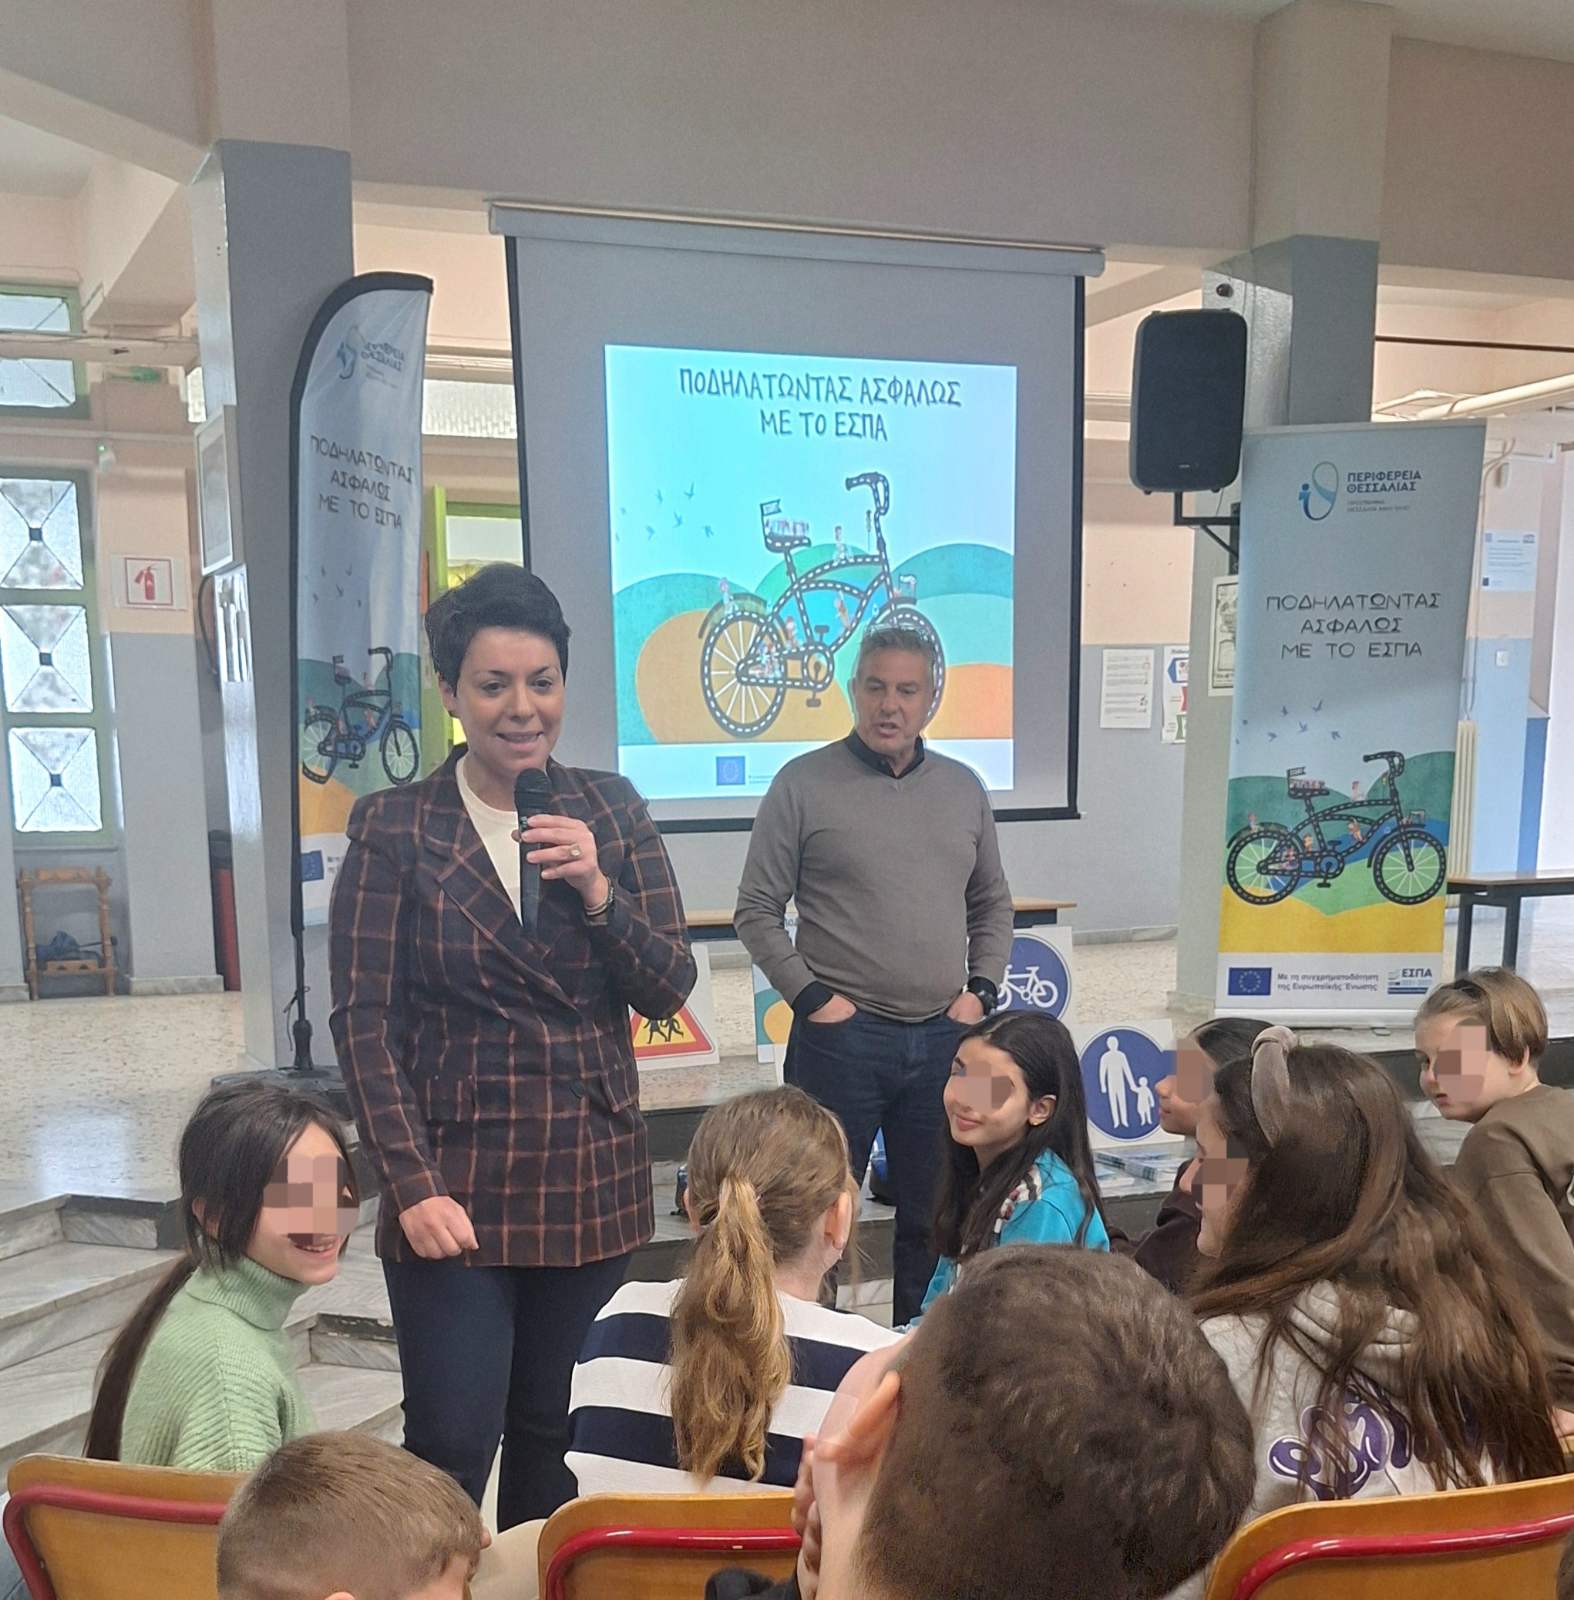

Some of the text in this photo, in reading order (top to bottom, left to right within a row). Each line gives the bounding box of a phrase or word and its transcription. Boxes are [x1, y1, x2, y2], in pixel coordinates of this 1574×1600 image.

[679, 368, 962, 408] ΠΟΔΗΛΑΤΩΝΤΑΣ ΑΣΦΑΛΩΣ
[760, 409, 888, 442] ΜΕ ΤΟ ΕΣΠΑ
[310, 434, 413, 484] ΠΟΔΗΛΑΤΩΝΤΑΣ
[1347, 470, 1422, 482] ΠΕΡΙΦΕΡΕΙΑ
[330, 470, 391, 502] ΑΣΦΑΛΩΣ
[1346, 482, 1417, 493] ΘΕΣΣΑΛΙΑΣ
[319, 493, 402, 529] ΜΕ ΤΟ ΕΣΠΑ
[1266, 592, 1442, 611] ΠΟΔΗΛΑΤΩΝΤΑΣ
[1300, 616, 1404, 635] ΑΣΦΑΛΩΣ
[1281, 641, 1423, 660] ΜΕ ΤΟ ΕΣΠΑ
[1401, 968, 1433, 978] ΕΣΠΑ
